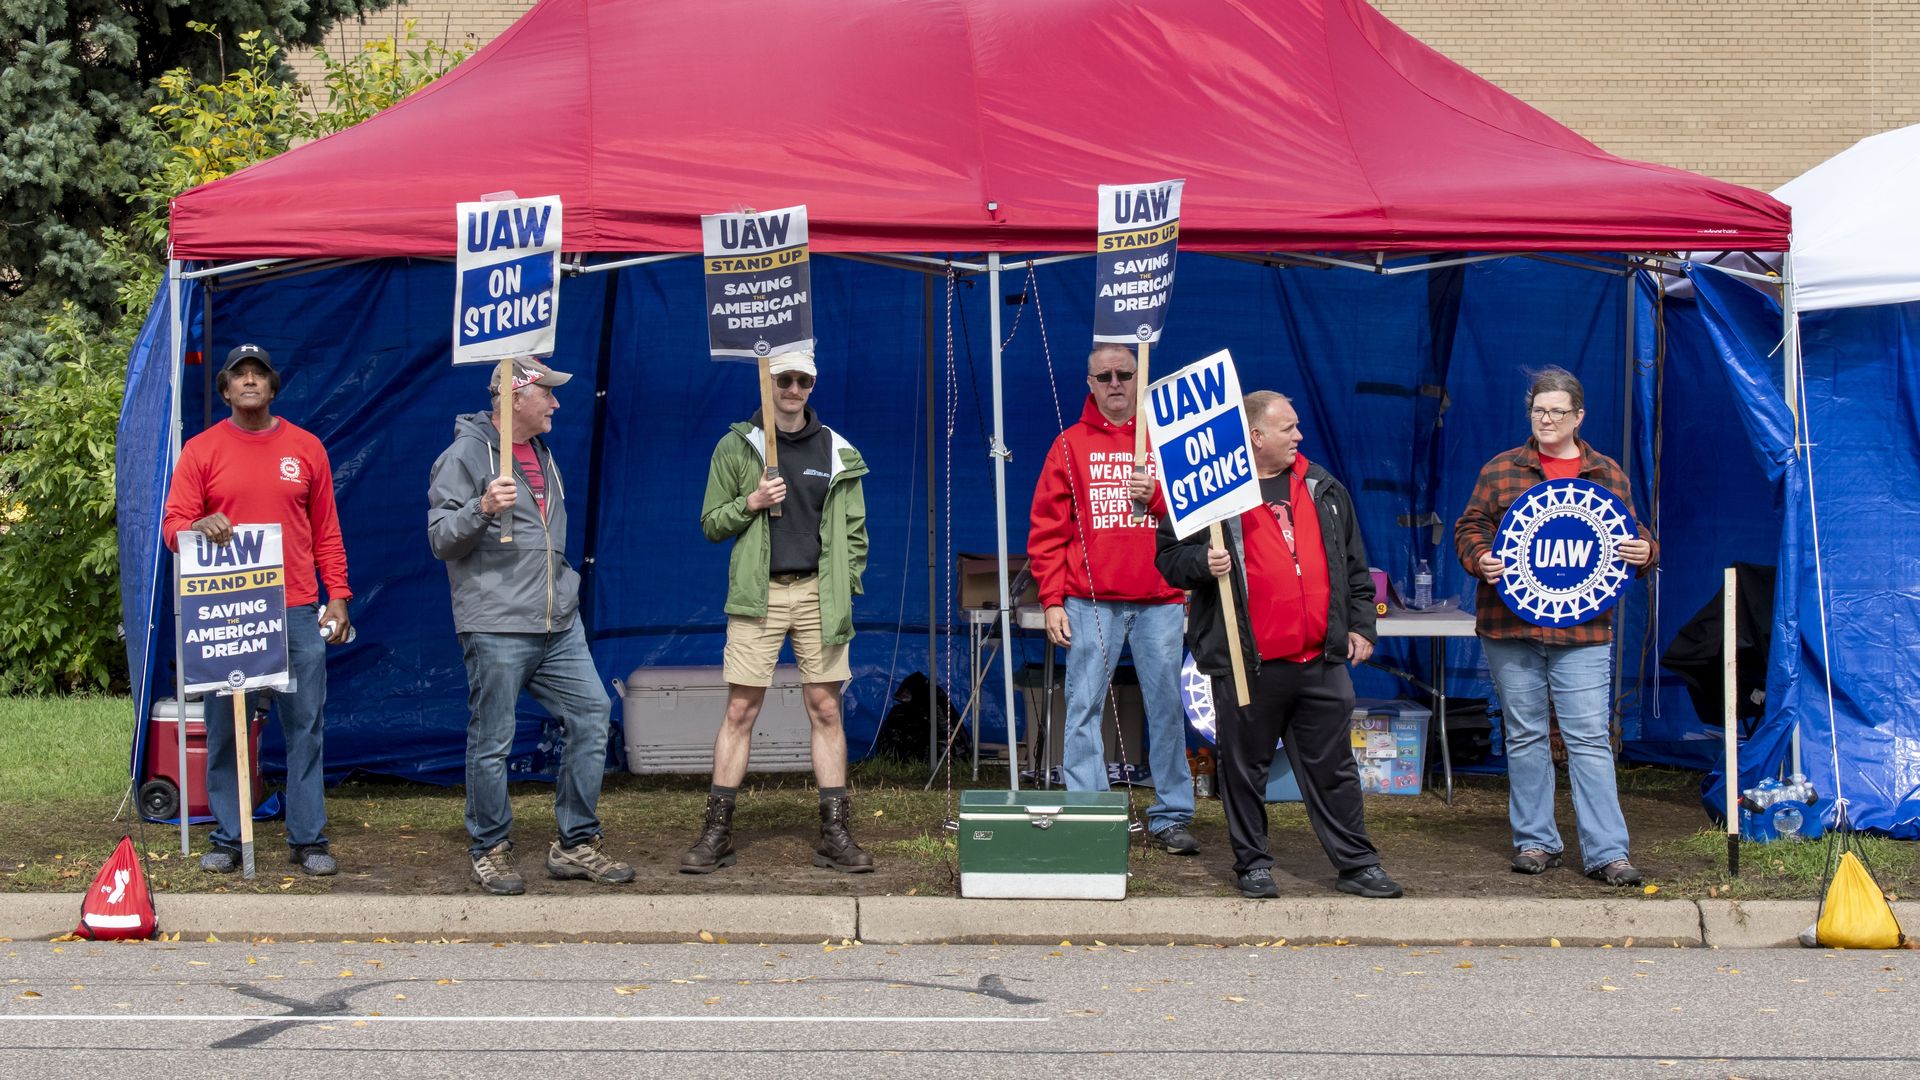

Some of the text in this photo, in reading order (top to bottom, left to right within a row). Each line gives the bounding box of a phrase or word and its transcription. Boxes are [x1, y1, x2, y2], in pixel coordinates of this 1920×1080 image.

[1114, 185, 1173, 224] UAW
[467, 205, 552, 253] UAW
[719, 213, 791, 250] UAW
[1103, 225, 1176, 250] STAND UP
[711, 249, 803, 272] STAND UP
[1113, 253, 1169, 275] SAVING
[488, 264, 522, 298] ON
[724, 275, 793, 296] SAVING
[1099, 271, 1174, 298] AMERICAN
[464, 290, 551, 337] STRIKE
[711, 291, 807, 315] AMERICAN
[1114, 291, 1167, 313] DREAM
[727, 309, 792, 330] DREAM
[1151, 361, 1226, 427] UAW
[1089, 452, 1106, 462] ON
[1185, 427, 1216, 466] ON
[1089, 464, 1132, 480] WEAR
[1171, 445, 1249, 510] STRIKE
[1535, 539, 1594, 568] UAW
[186, 571, 277, 592] STAND UP
[198, 599, 267, 620] SAVING
[185, 618, 282, 643] AMERICAN
[202, 637, 267, 659] DREAM
